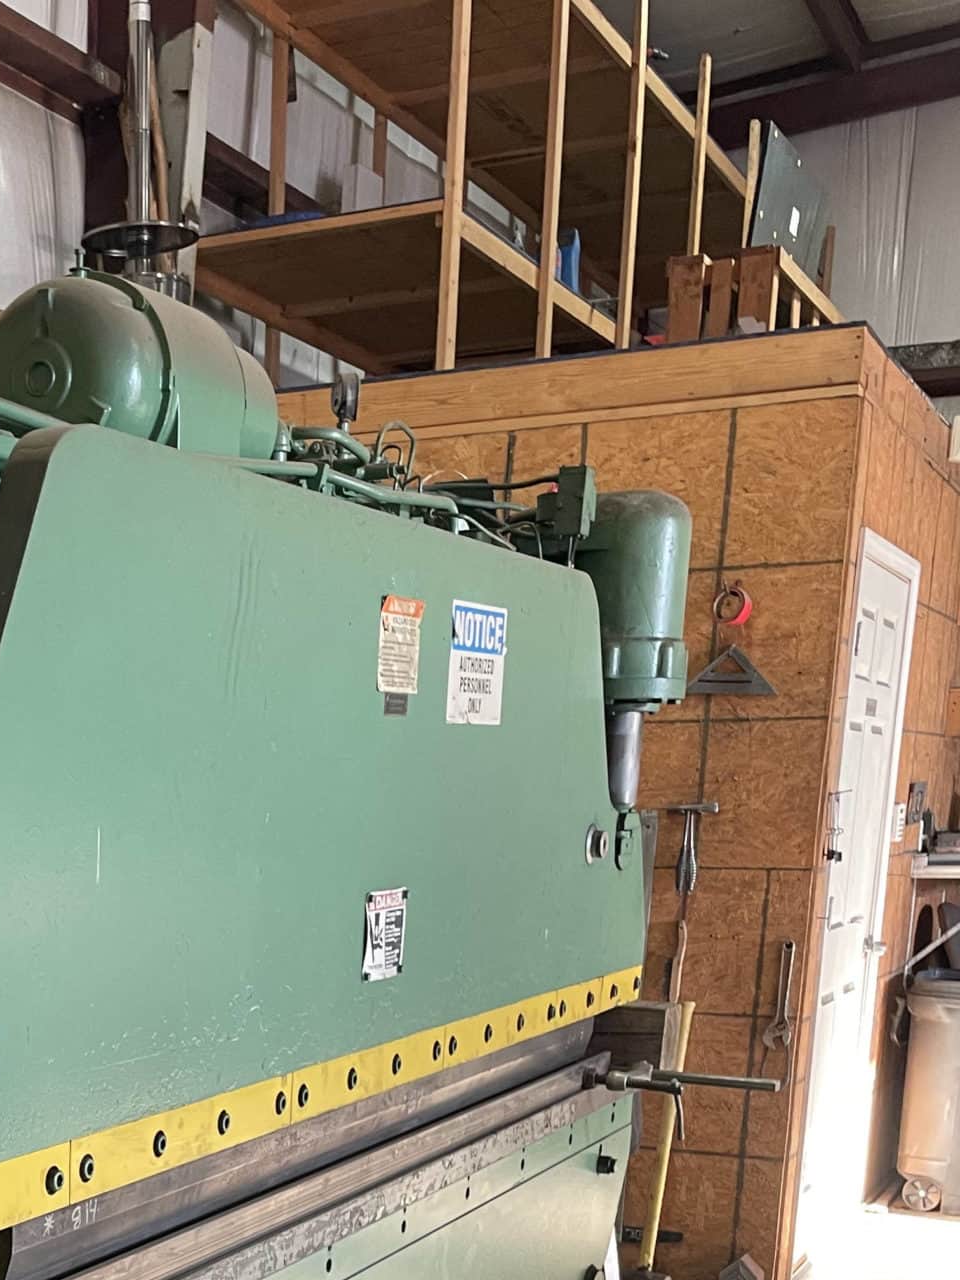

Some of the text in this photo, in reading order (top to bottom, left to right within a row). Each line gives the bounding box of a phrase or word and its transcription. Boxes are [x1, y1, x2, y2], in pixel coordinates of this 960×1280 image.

[454, 609, 504, 653] NOTICE
[459, 656, 495, 675] AUTHORIZED
[459, 677, 493, 695] PERSONNEL
[467, 697, 482, 714] ONLY
